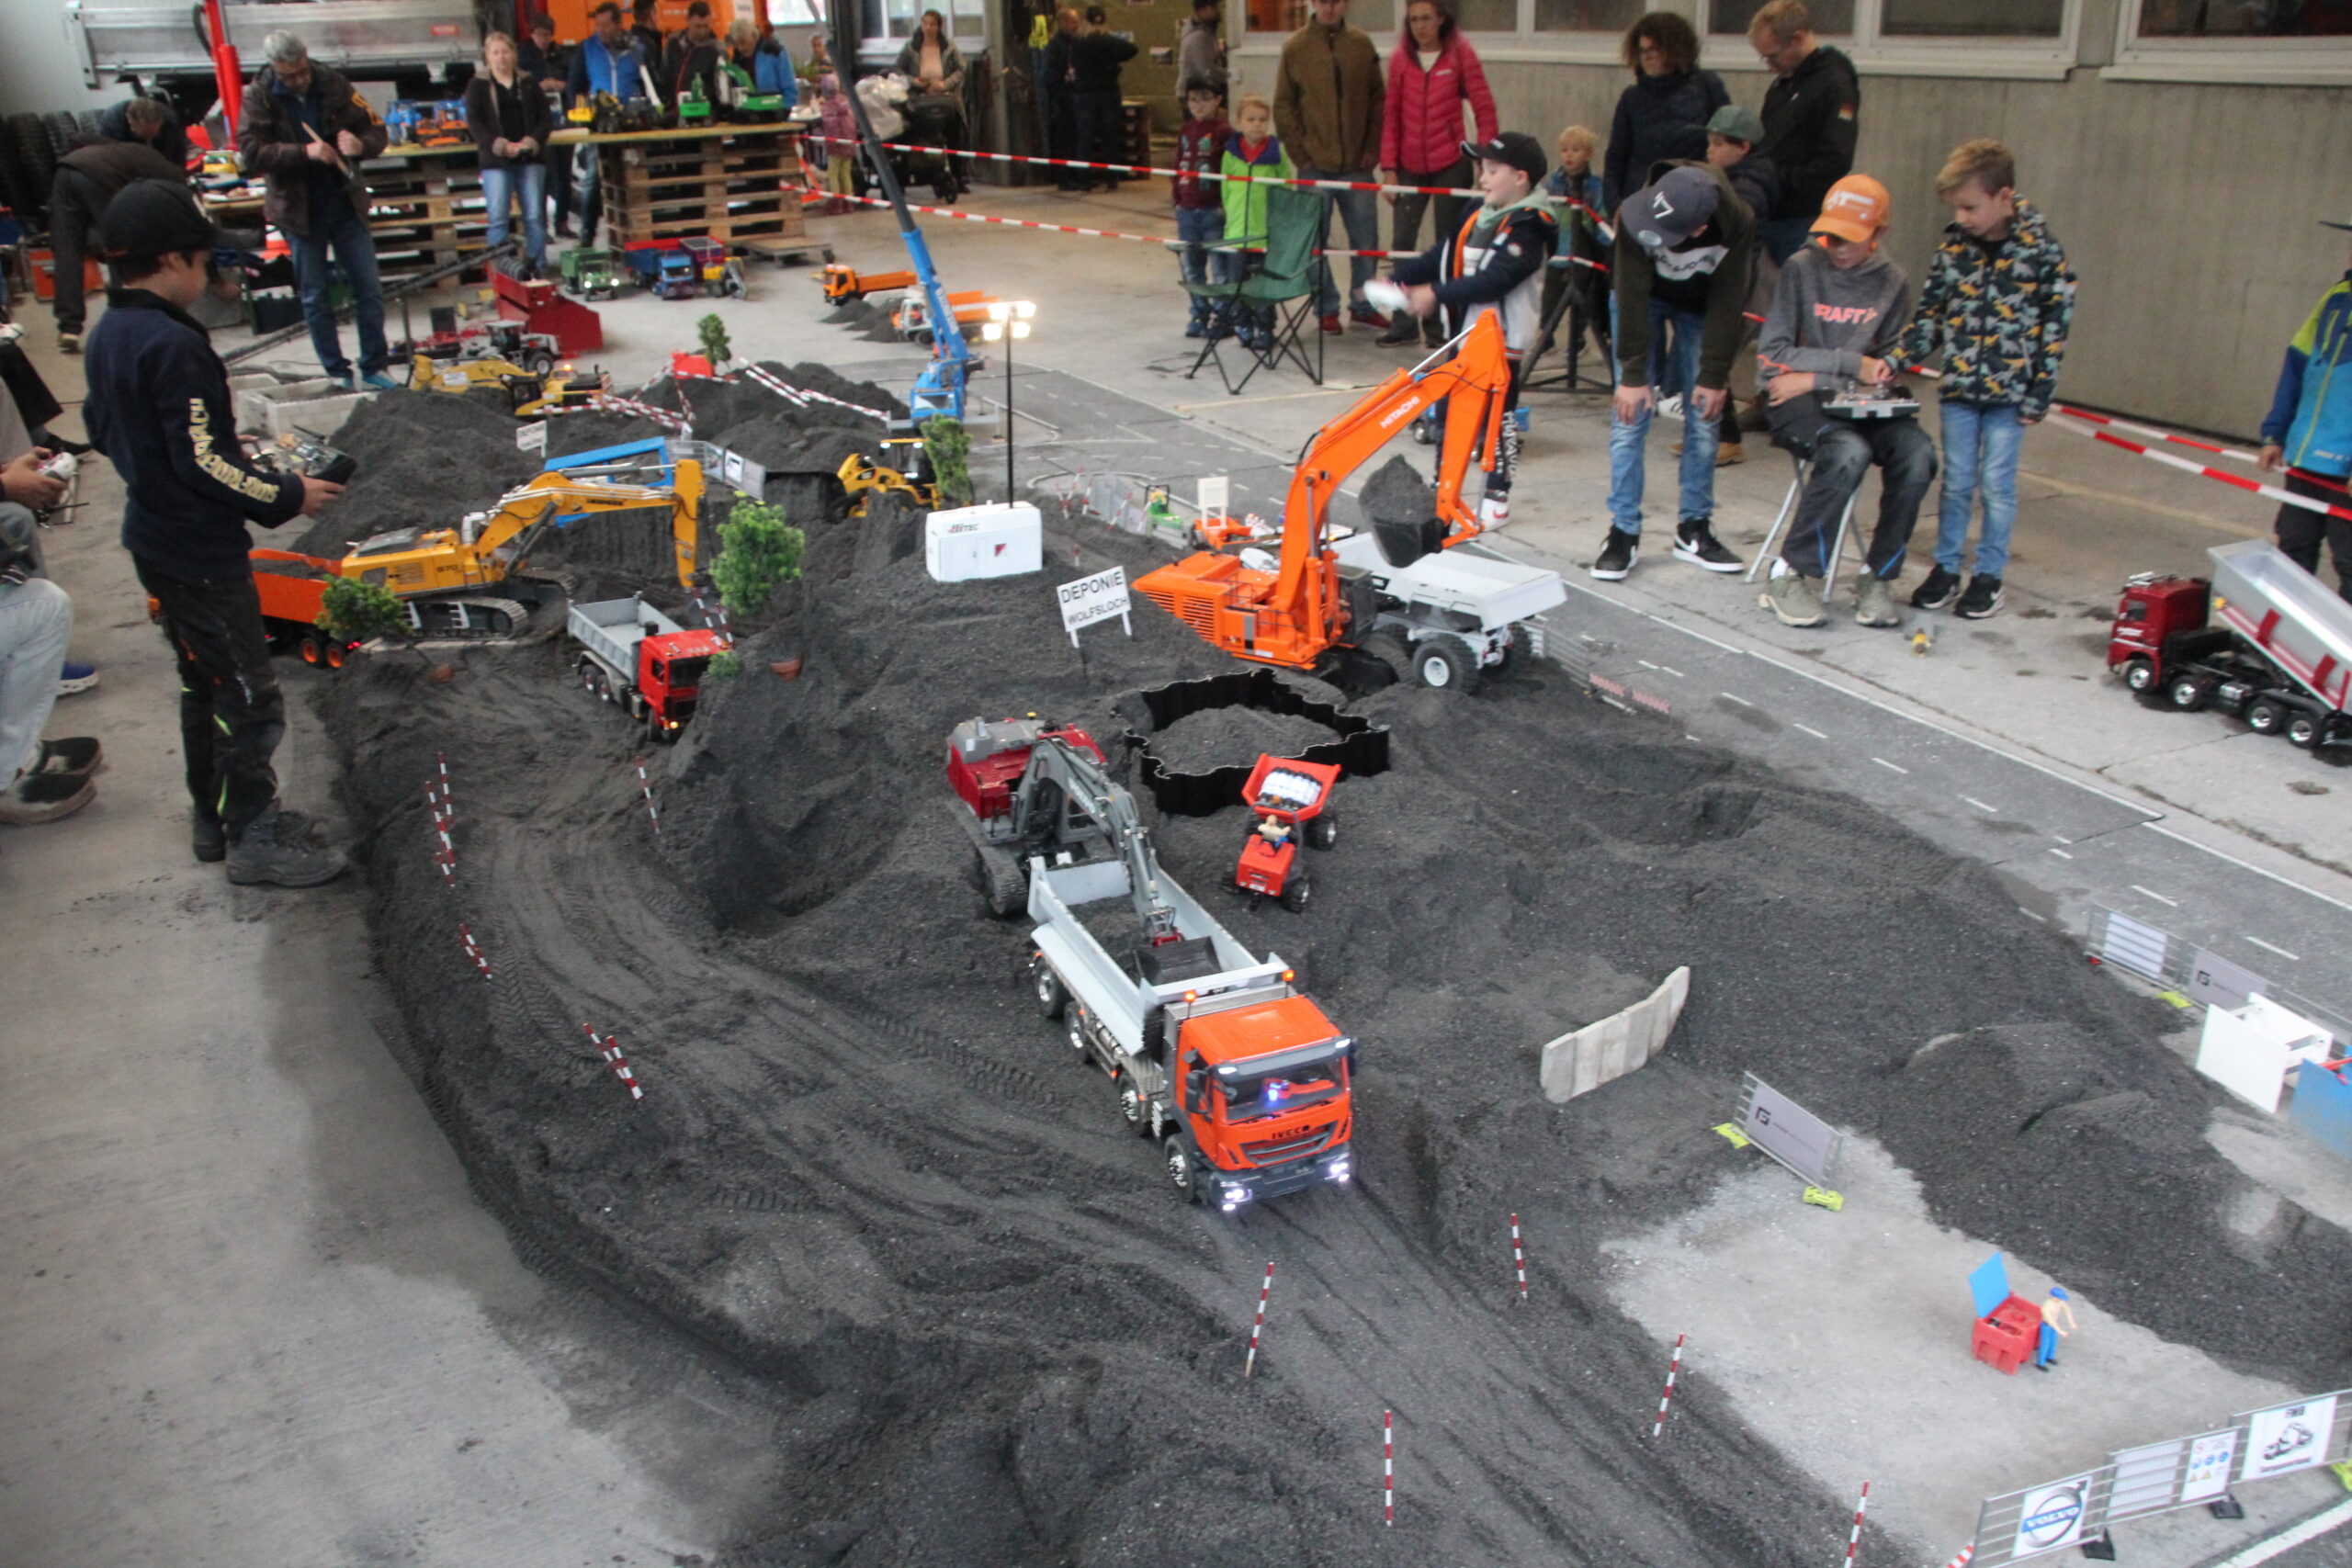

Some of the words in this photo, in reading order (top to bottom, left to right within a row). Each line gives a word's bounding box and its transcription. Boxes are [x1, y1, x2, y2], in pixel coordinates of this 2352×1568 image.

[1060, 570, 1124, 604] DEPONIE
[1067, 596, 1127, 626] WOLFSLOCH
[1272, 1124, 1310, 1139] IVECO
[2025, 1506, 2080, 1528] VOLVO
